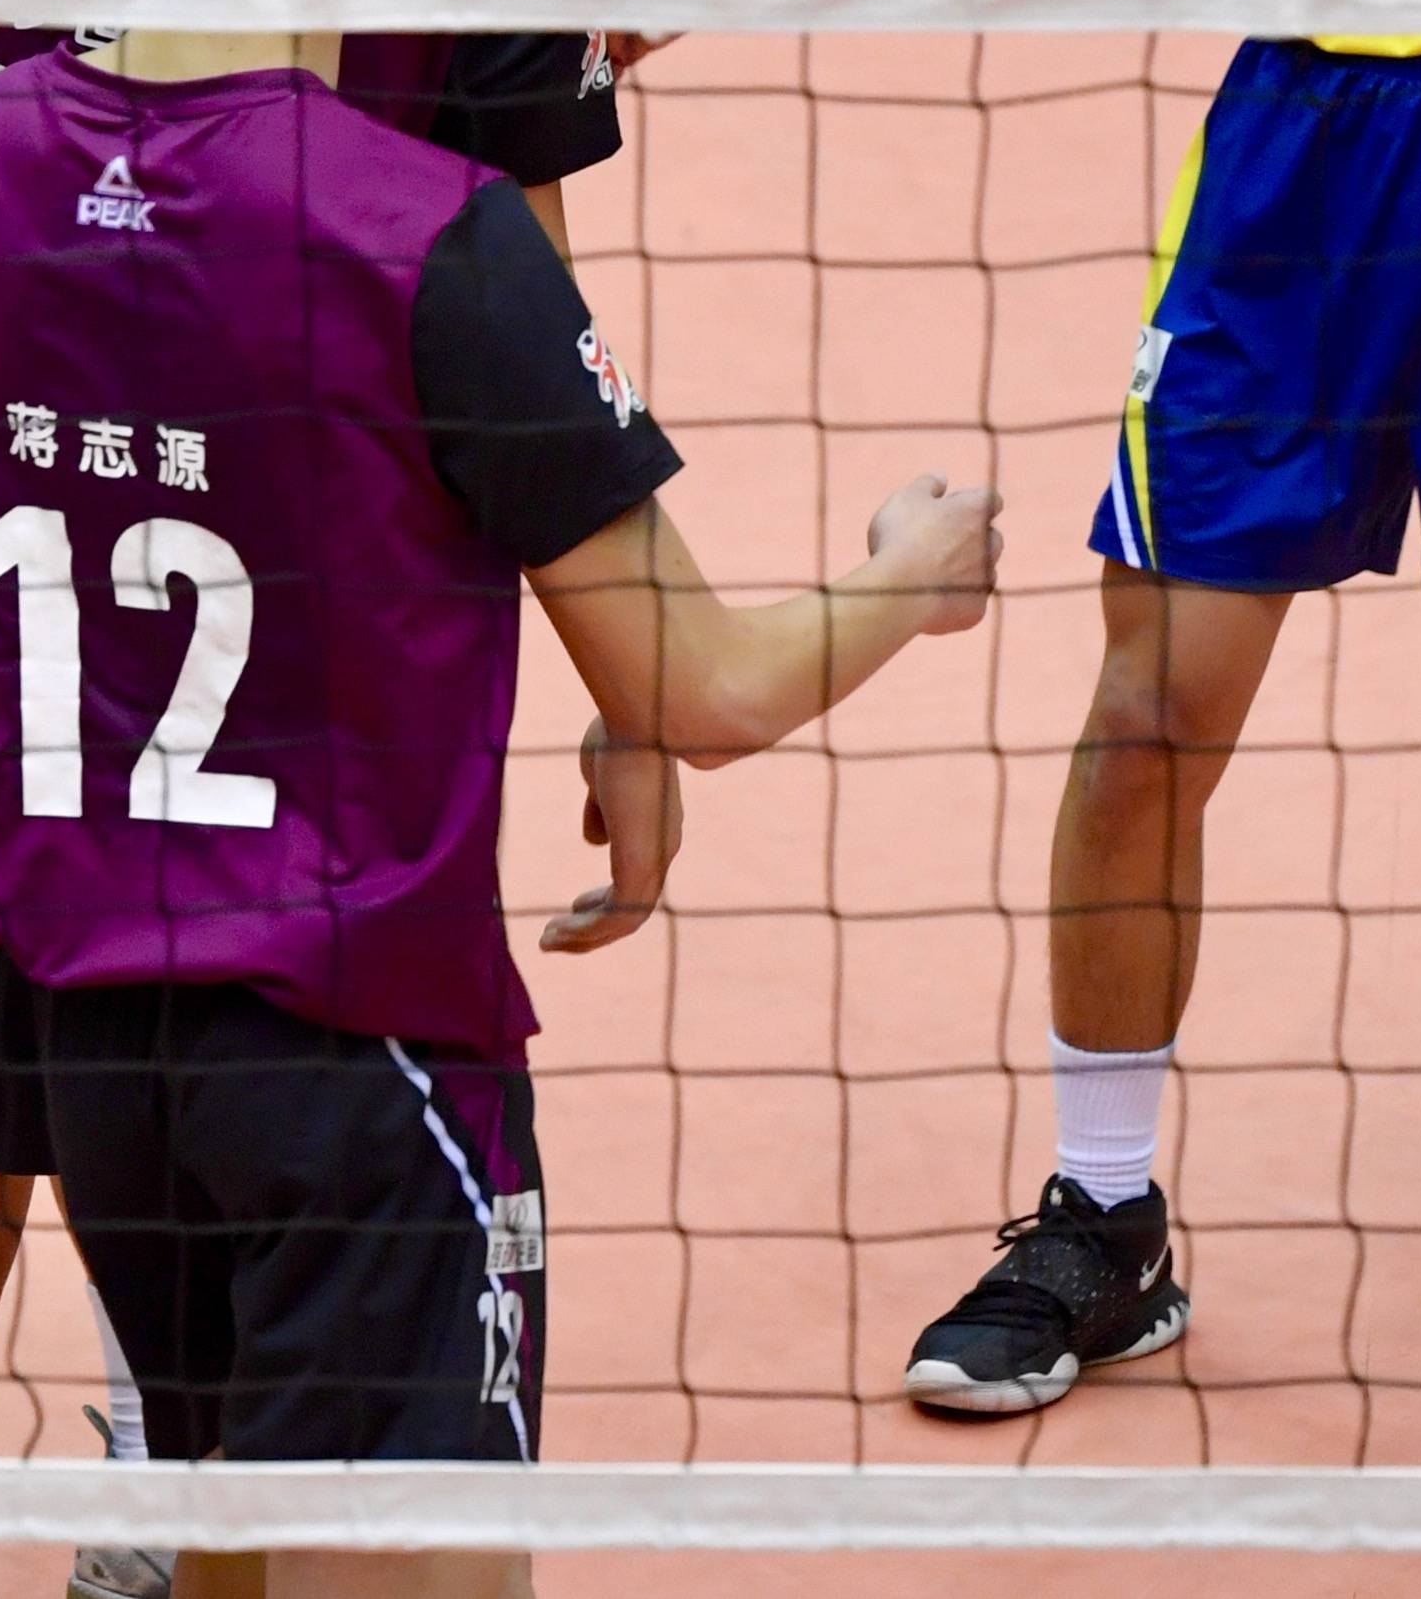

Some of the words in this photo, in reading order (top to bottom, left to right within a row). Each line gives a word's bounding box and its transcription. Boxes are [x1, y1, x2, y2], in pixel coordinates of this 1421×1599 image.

[77, 194, 157, 232] PEAK
[6, 401, 210, 493] 蒋志源
[477, 1290, 524, 1404] 12
